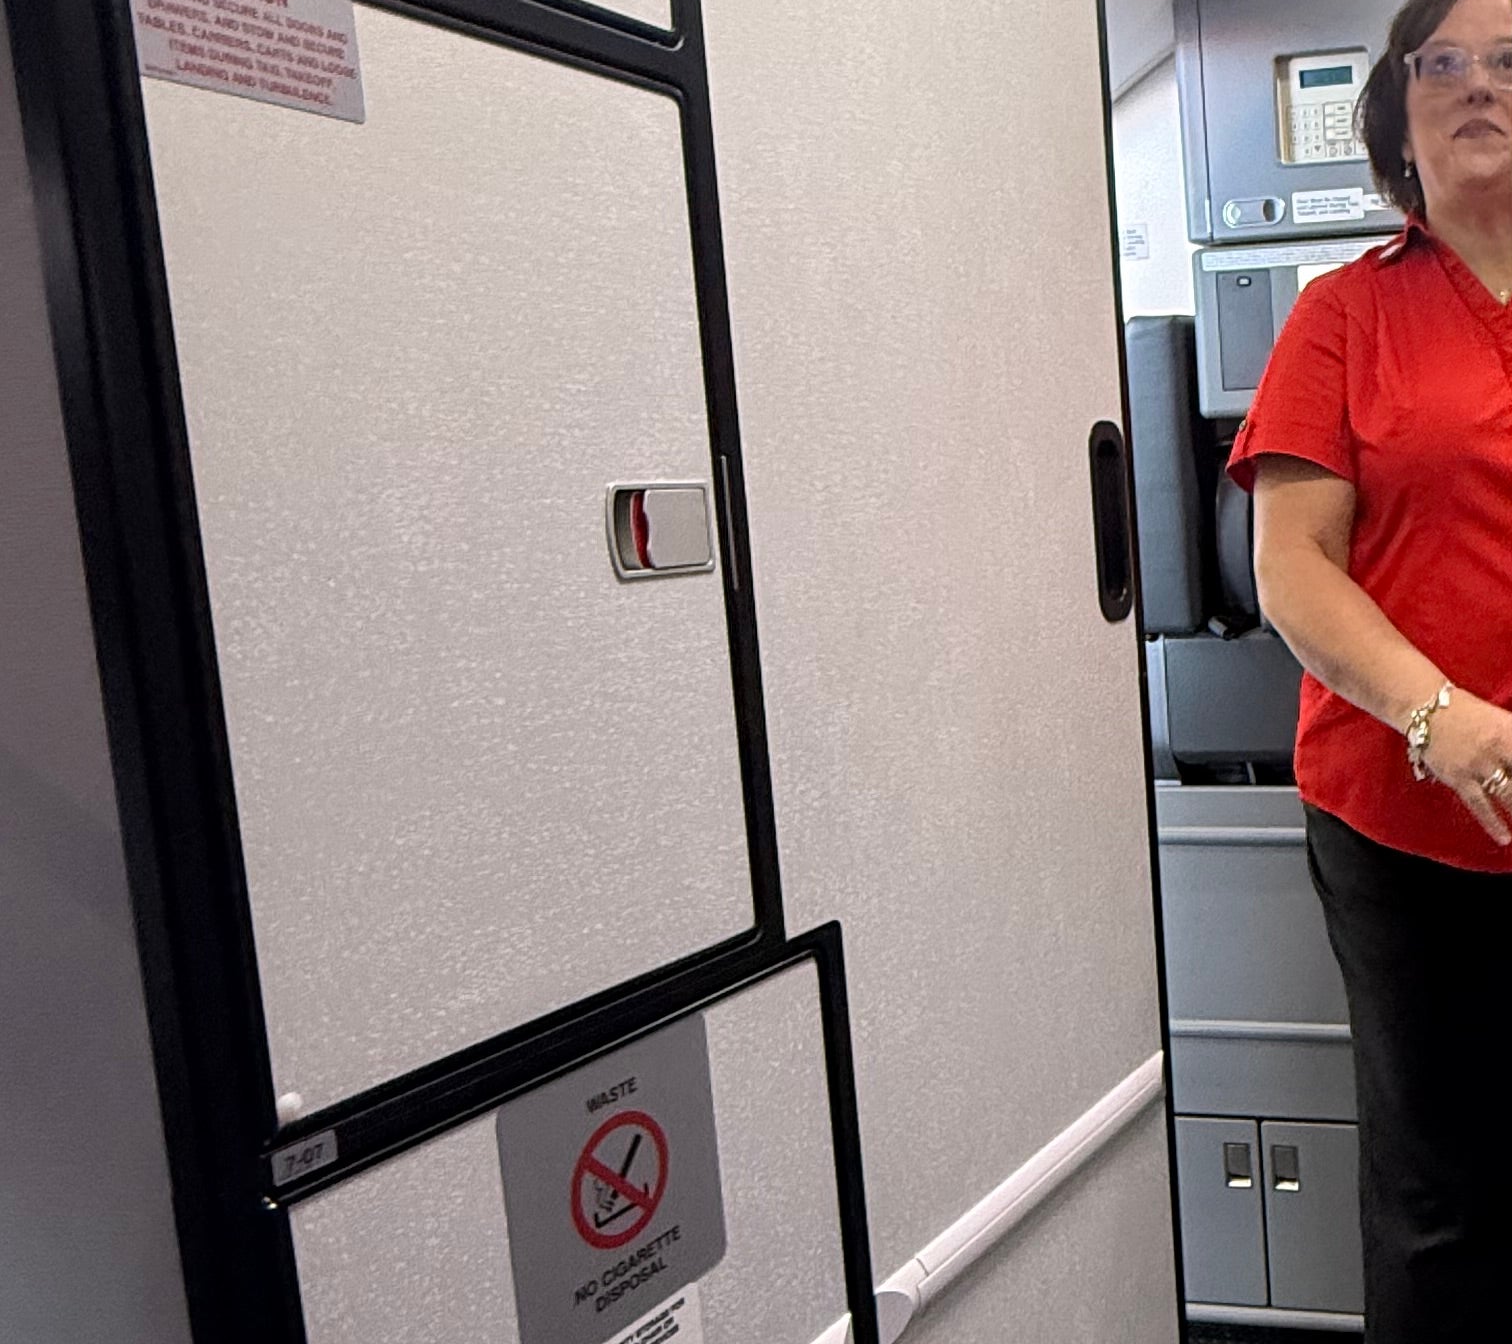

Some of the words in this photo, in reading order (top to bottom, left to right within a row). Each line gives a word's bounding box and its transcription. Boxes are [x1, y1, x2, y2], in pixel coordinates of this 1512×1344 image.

[585, 1075, 639, 1113] WASTE
[282, 1142, 325, 1171] 7-07
[573, 1279, 598, 1308] NO
[601, 1224, 681, 1288] CIGARETTE
[595, 1256, 669, 1313] DISPOSAL
